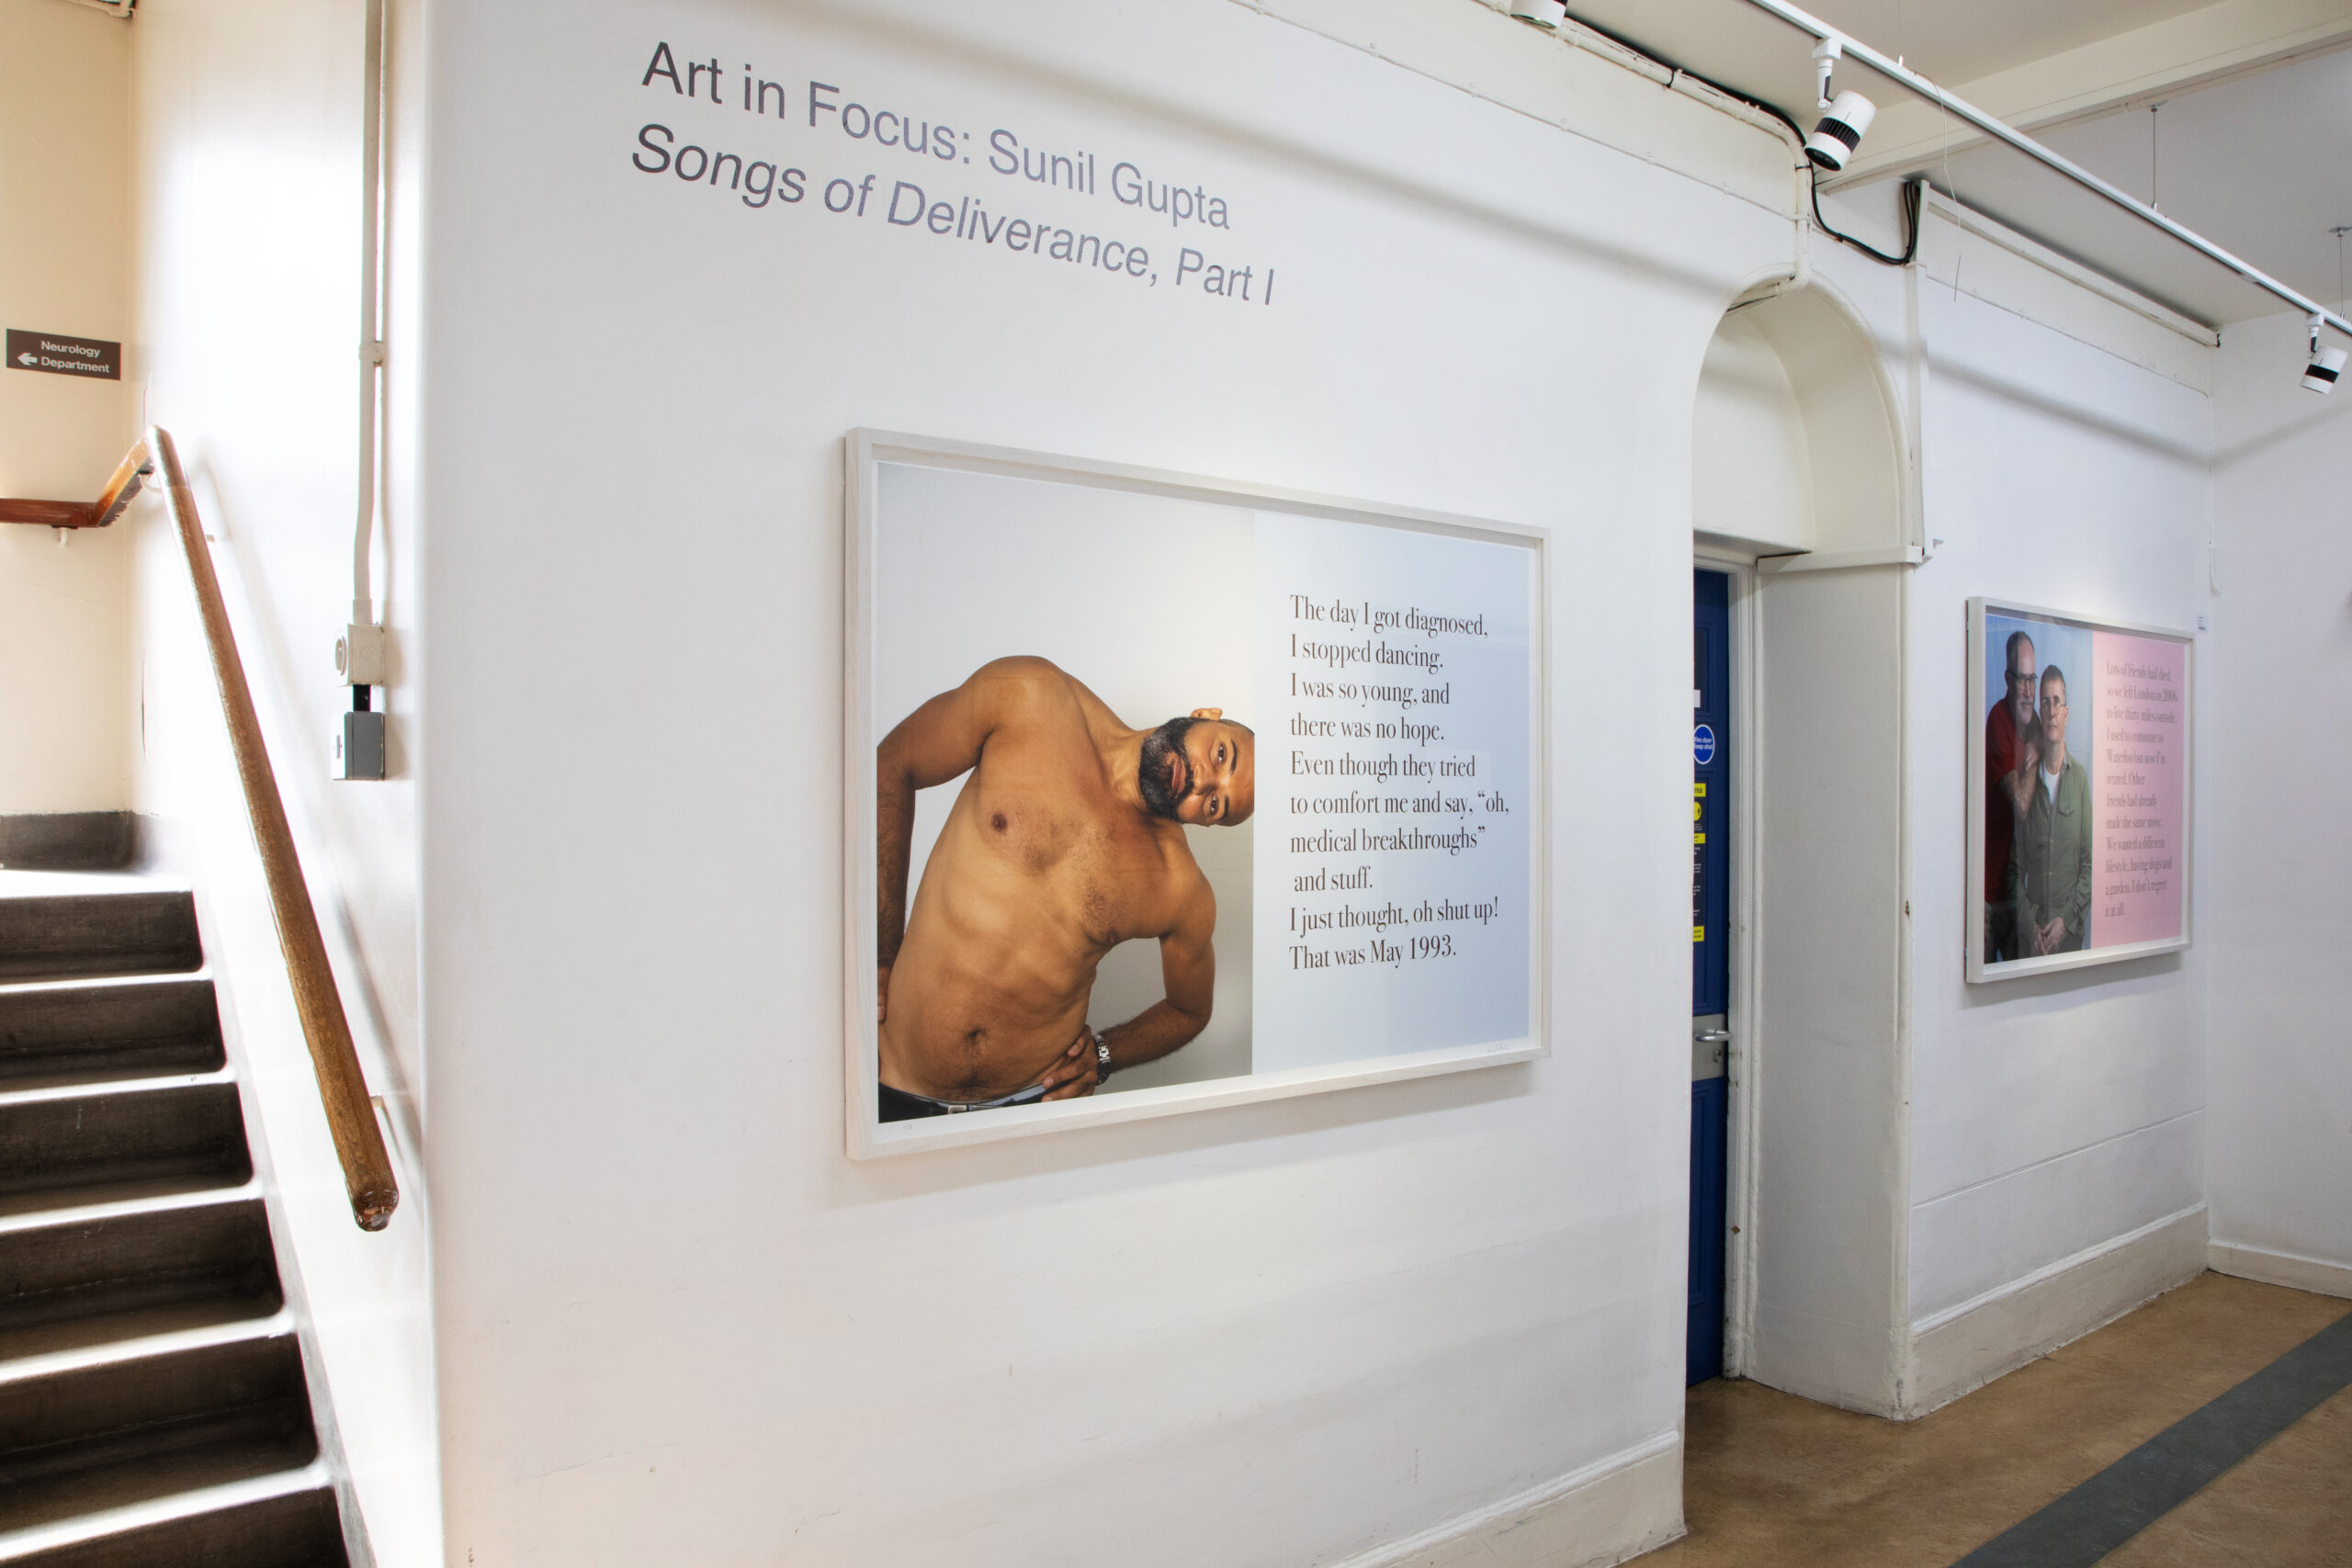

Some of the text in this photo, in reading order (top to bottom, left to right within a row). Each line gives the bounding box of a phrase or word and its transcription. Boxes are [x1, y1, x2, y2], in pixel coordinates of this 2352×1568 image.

[641, 41, 1231, 231] Art in Focus: Sunil Gupta
[632, 123, 1275, 306] Songs of Deliverance, Part I
[40, 340, 101, 358] Neurology
[40, 356, 110, 373] Department
[1290, 595, 1487, 638] The day I got diagnosed,
[1291, 634, 1443, 674] I stopped dancing.
[1291, 672, 1450, 710] I was so young, and
[1290, 712, 1444, 747] there was no hope.
[1291, 750, 1476, 784] Even though they tried
[1290, 790, 1510, 819] to comfort me and say, “oh,
[2106, 793, 2157, 811] friends had already
[2106, 816, 2121, 829] made
[2122, 816, 2131, 829] the
[2131, 818, 2146, 828] same
[1290, 826, 1485, 855] medical breakthroughs”
[2106, 837, 2116, 851] We
[2117, 836, 2137, 850] wanted
[2142, 836, 2165, 850] different
[1295, 865, 1373, 892] and stuff.
[1289, 896, 1498, 938] I just thought, oh shut up!
[1289, 934, 1456, 970] That was May 1993.
